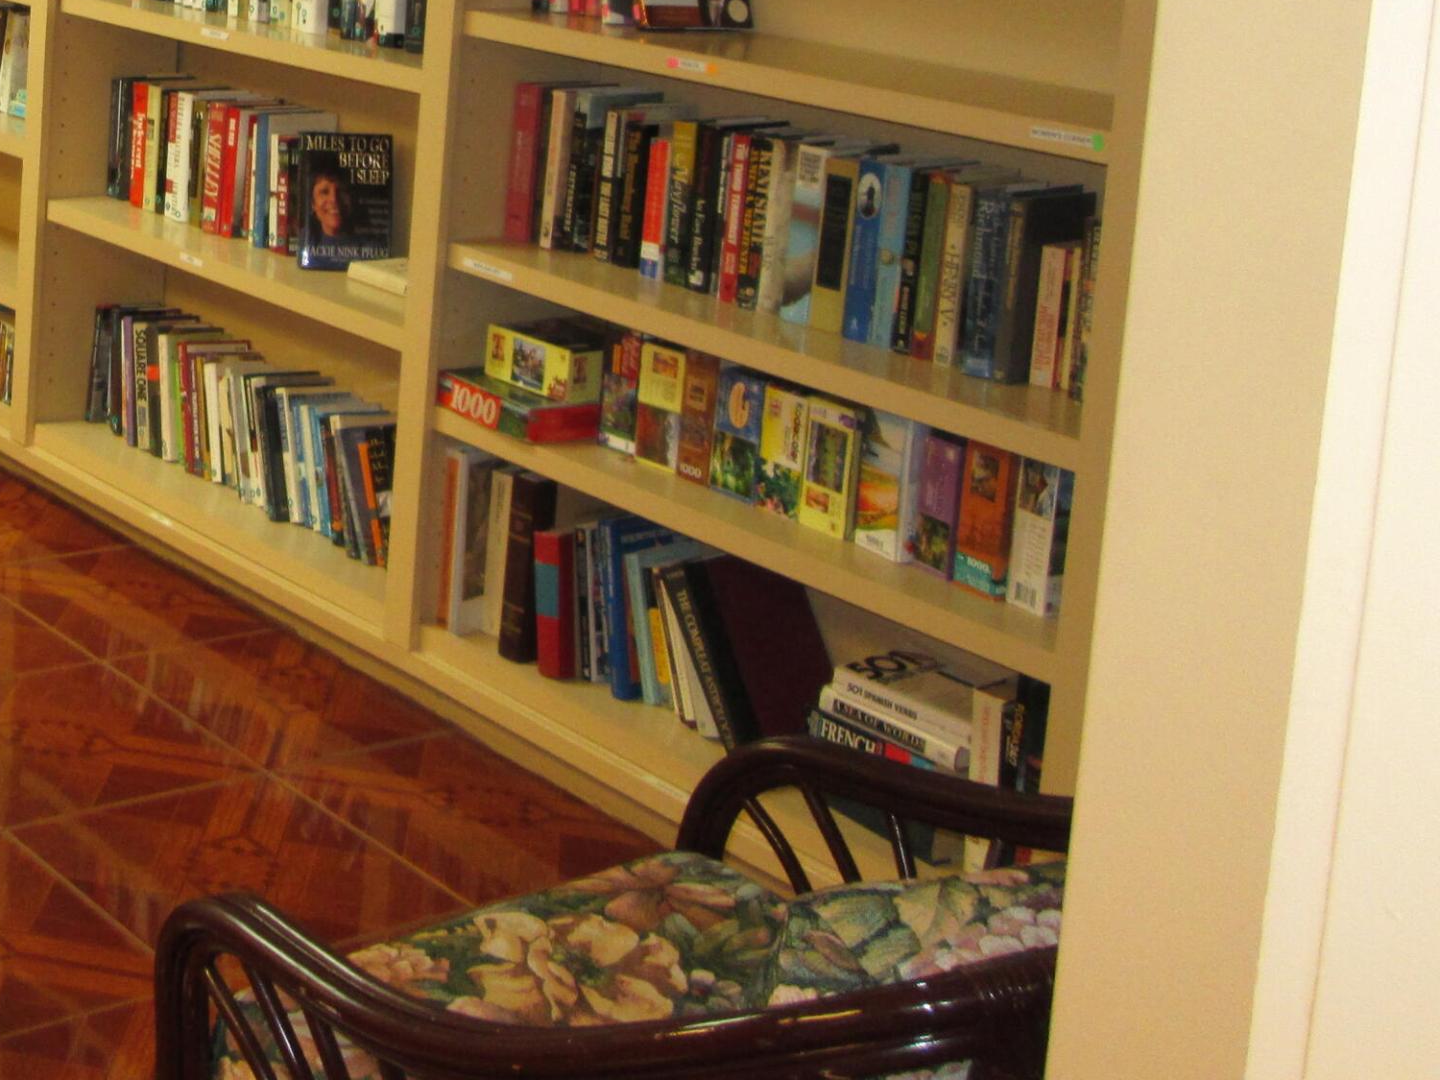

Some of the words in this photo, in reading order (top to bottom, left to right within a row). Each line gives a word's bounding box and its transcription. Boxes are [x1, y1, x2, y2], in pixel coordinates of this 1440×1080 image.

[306, 135, 345, 151] MILES
[350, 137, 367, 152] TO
[369, 137, 389, 152] GO
[339, 152, 389, 169] BEFORE
[204, 133, 222, 202] SHELLEY
[357, 170, 390, 185] SLEEP
[733, 163, 746, 189] THIRD
[756, 151, 774, 184] KENT
[669, 166, 689, 243] Mayflower
[753, 185, 772, 243] STATE
[971, 200, 993, 277] Richmond
[939, 253, 956, 306] HENRY
[135, 329, 147, 375] SQUARE
[136, 378, 148, 401] ONE
[449, 381, 498, 426] 1000
